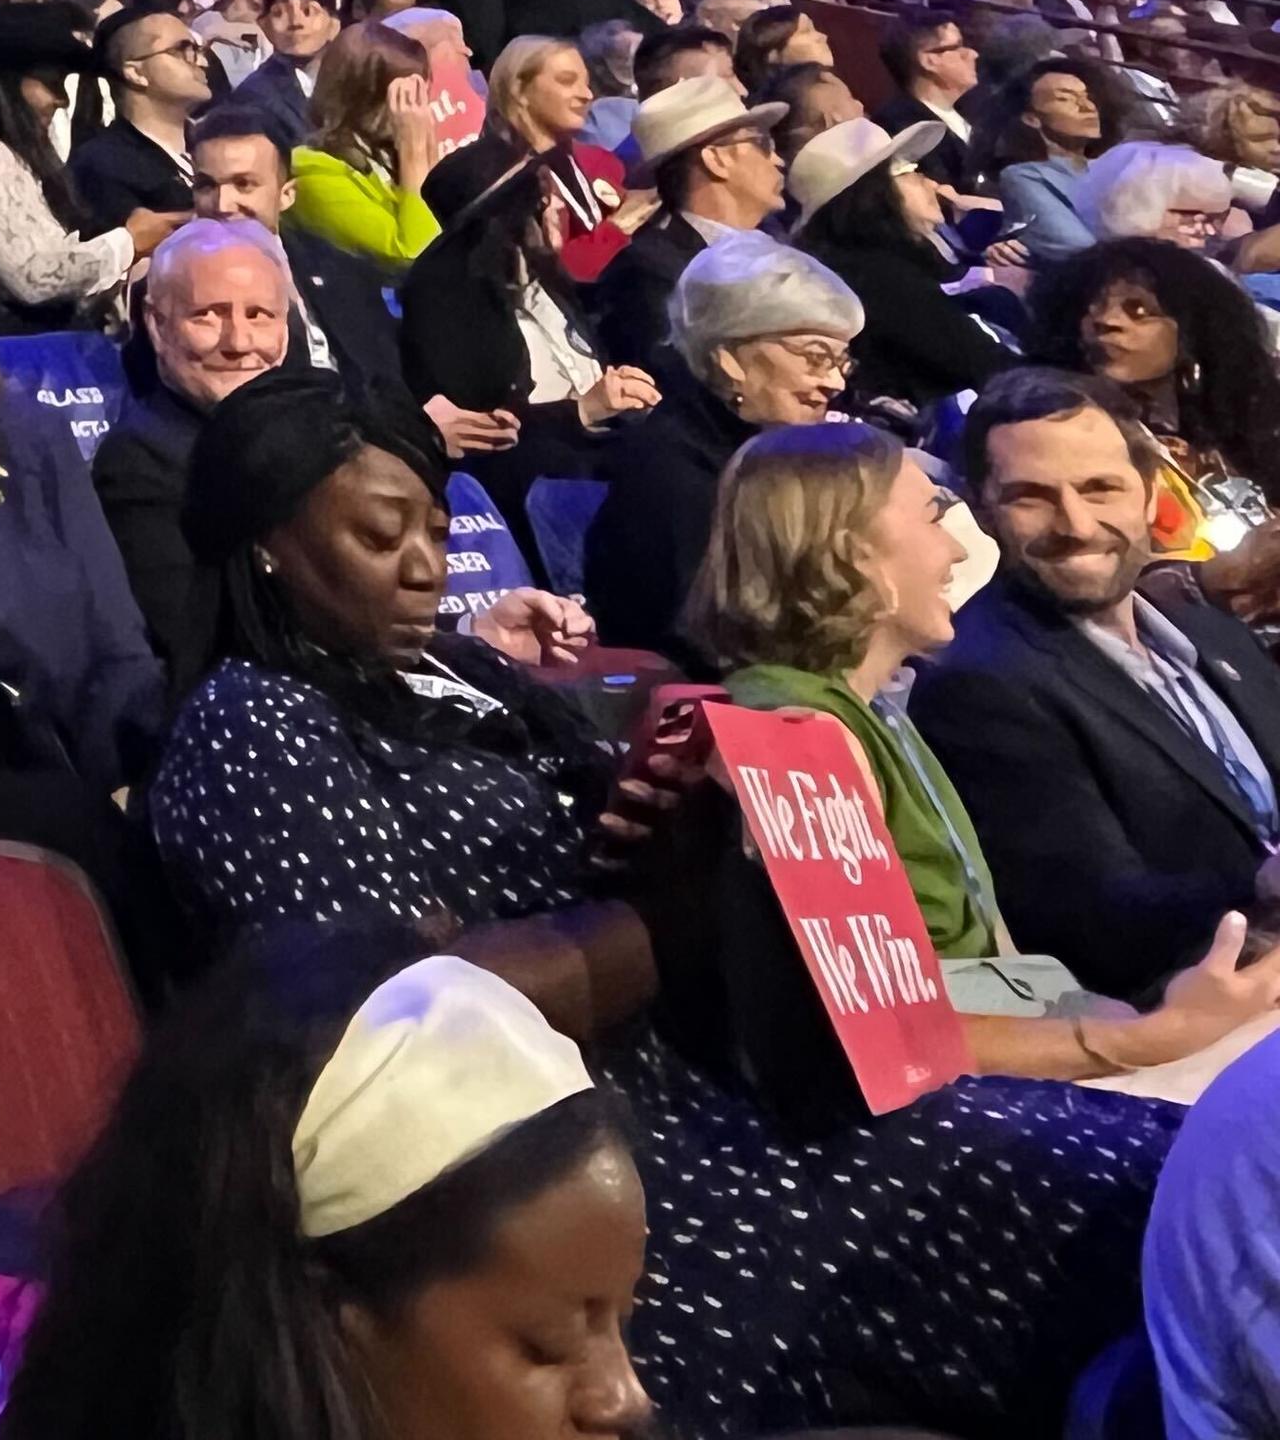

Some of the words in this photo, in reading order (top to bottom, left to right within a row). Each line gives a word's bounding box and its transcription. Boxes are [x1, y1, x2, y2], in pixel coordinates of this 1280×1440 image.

[738, 765, 803, 861] We
[788, 770, 891, 885] Fight,
[799, 917, 869, 1016] We
[846, 914, 938, 1008] Win.
